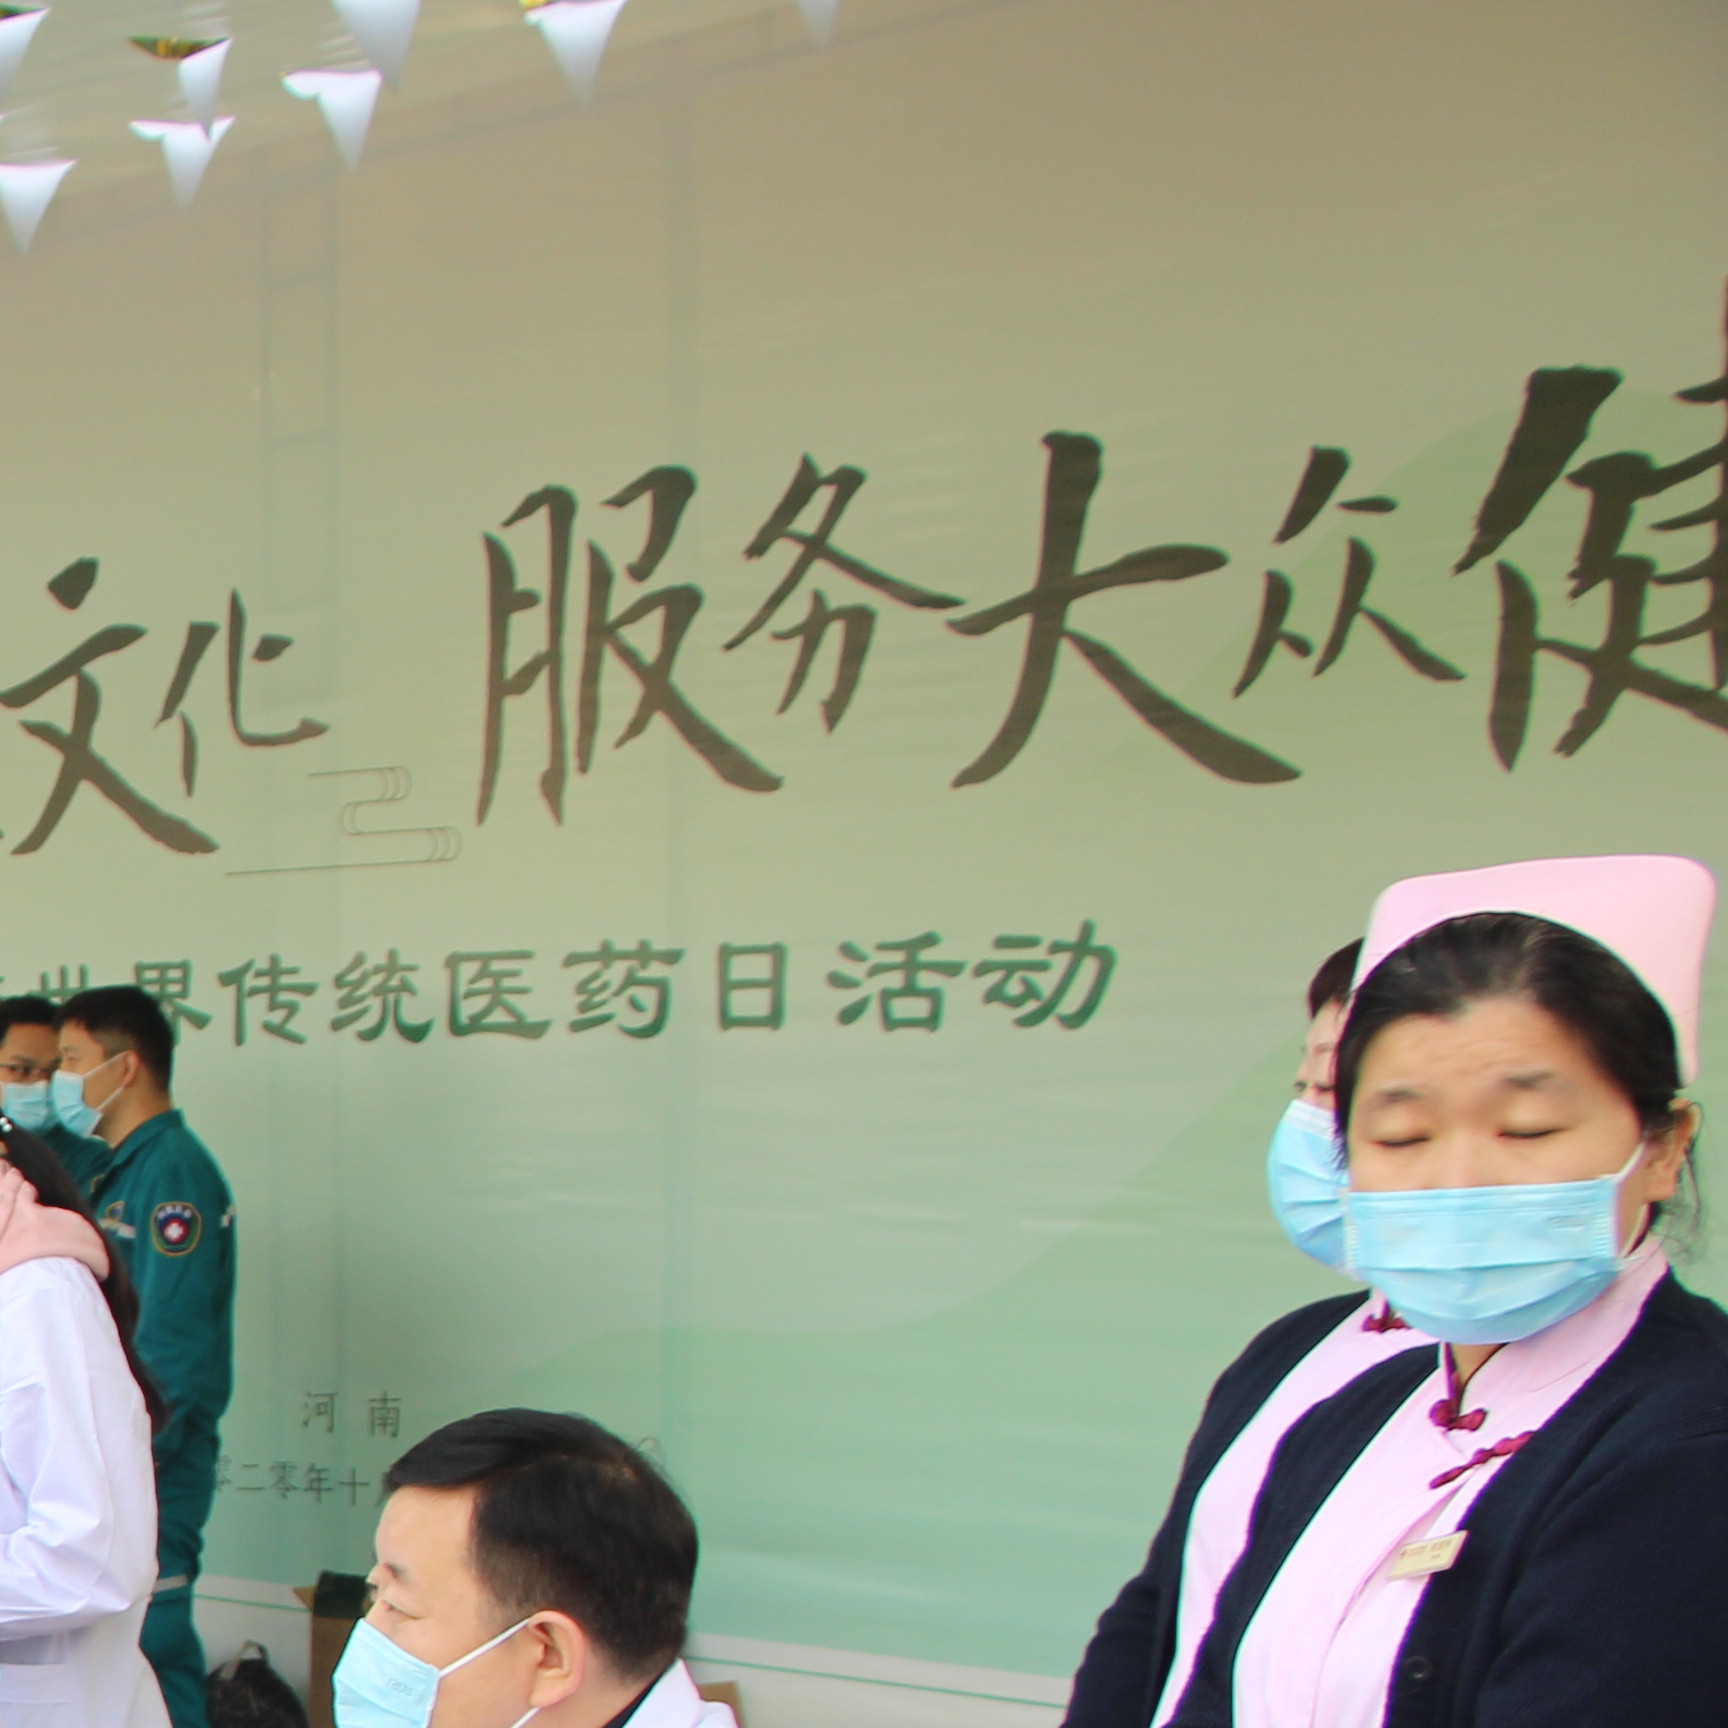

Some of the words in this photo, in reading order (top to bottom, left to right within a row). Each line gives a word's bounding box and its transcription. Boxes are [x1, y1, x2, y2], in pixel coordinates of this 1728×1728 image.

[301, 1390, 402, 1438] 河南
[216, 1455, 394, 1508] 二零年十
